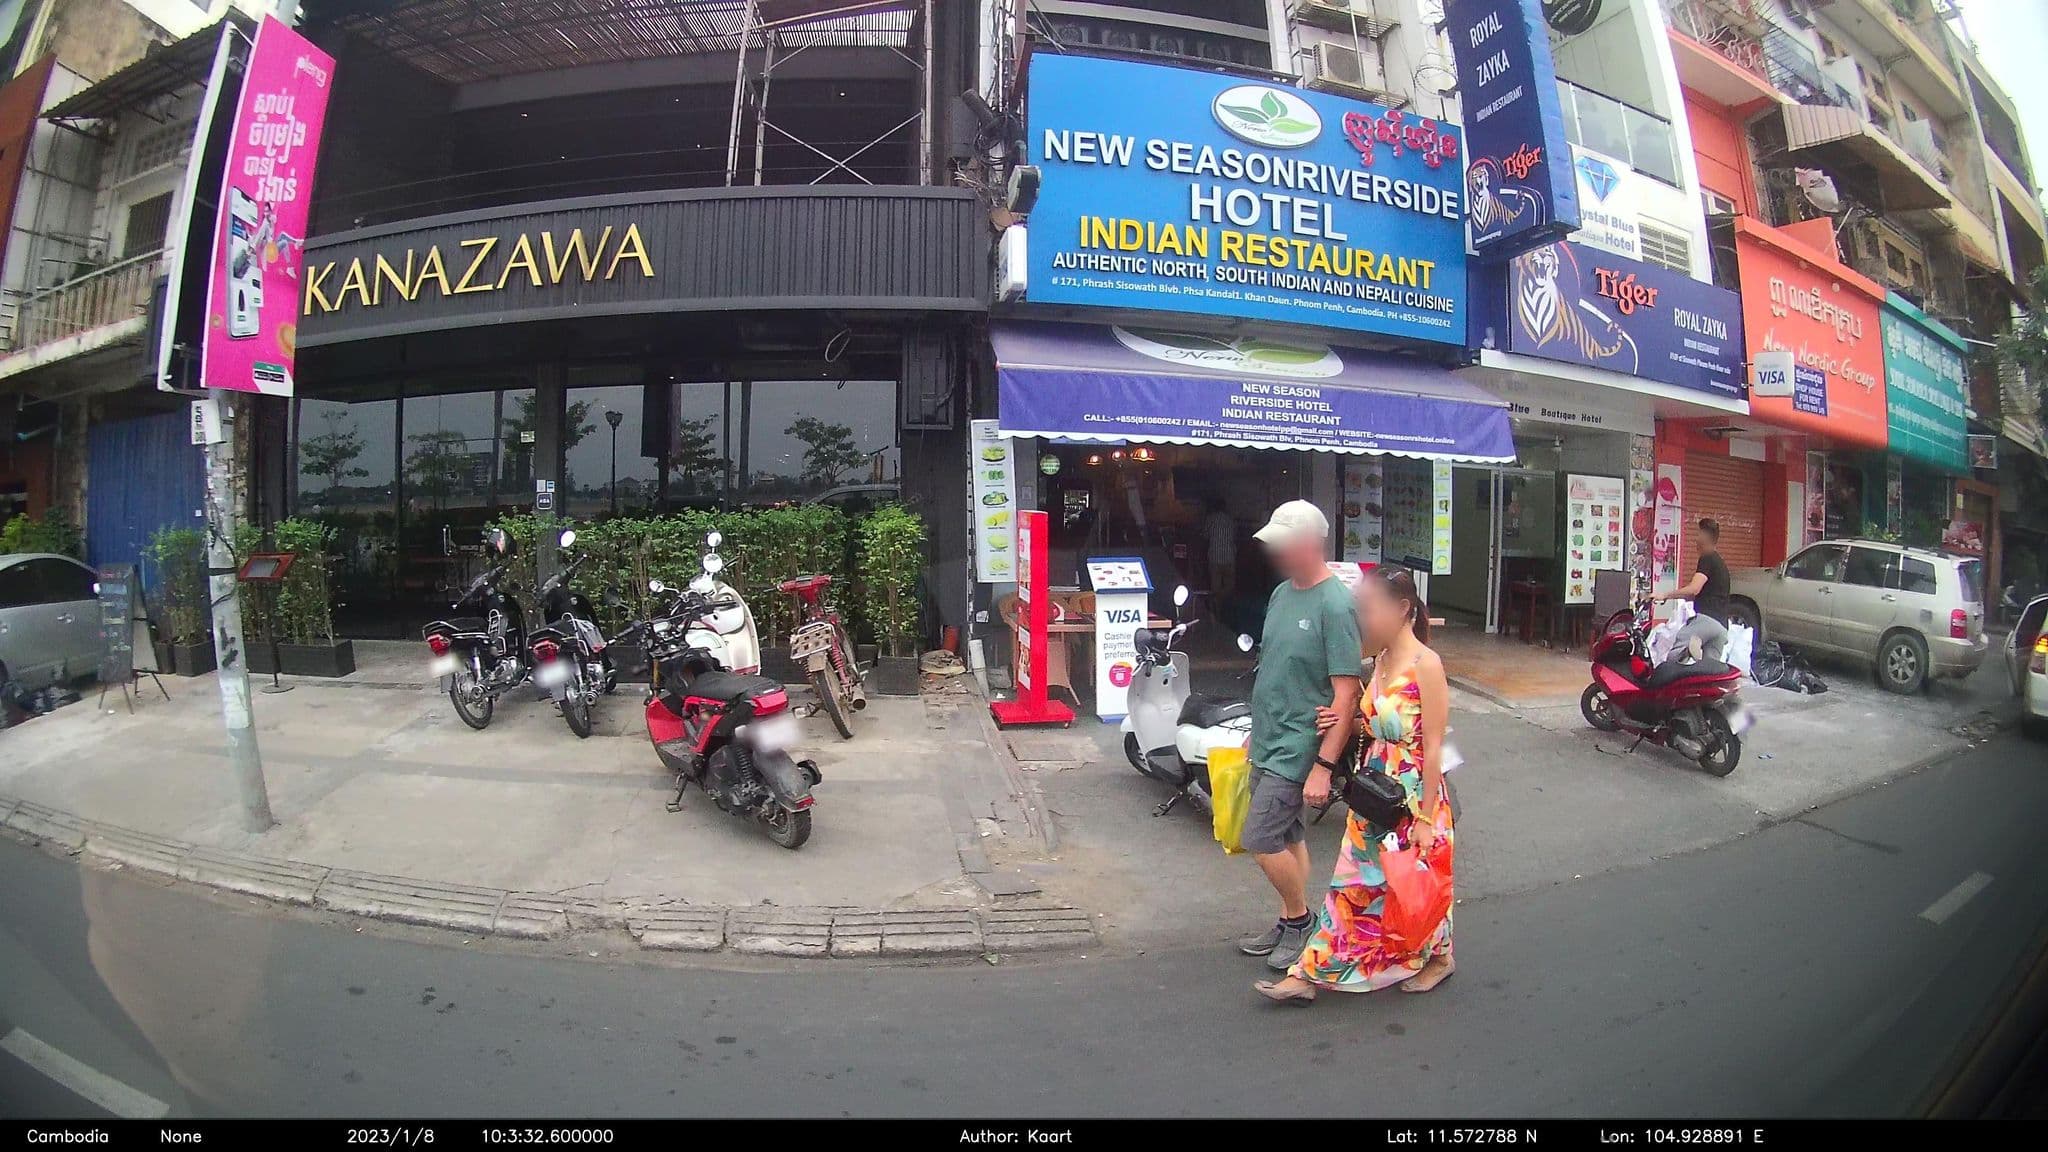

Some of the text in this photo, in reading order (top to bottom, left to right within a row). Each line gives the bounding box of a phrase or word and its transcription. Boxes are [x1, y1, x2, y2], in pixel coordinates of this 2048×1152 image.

[1470, 11, 1502, 48] ROYAL
[1476, 49, 1510, 87] ZAYKA
[1492, 85, 1523, 113] RESTAURANT
[1044, 129, 1135, 166] NEW
[1503, 143, 1542, 180] Tiger
[1191, 183, 1347, 242] HOTEL
[1581, 209, 1634, 233] ystal Blue
[1080, 216, 1435, 289] INDIAN RESTAURANT
[1605, 232, 1635, 252] Hotel
[303, 222, 655, 316] KANAZAWA
[1053, 252, 1454, 313] AUTHENTIC NORTH, SOUTH INDIAN AND NEPALI CUISINE
[1060, 277, 1080, 287] 171,
[1082, 278, 1114, 289] Phrash
[1115, 281, 1157, 292] Sisowath
[1183, 287, 1203, 296] Phsa
[1244, 292, 1266, 303] Khan
[1294, 298, 1322, 309] Phnom
[1323, 302, 1345, 314] Penh,
[1346, 305, 1386, 319] Cambodia.
[1387, 311, 1398, 320] PH
[1594, 267, 1658, 315] Tiger
[1674, 308, 1728, 341] ROYAL ZAYKA
[1758, 371, 1785, 384] VISA
[1798, 339, 1838, 375] Nordic
[1841, 358, 1876, 394] Group
[1230, 395, 1333, 412] RIVERSIDE HOTEL
[1243, 383, 1320, 399] NEW SEASON
[1222, 408, 1341, 426] INDIAN RESTAURANT
[1508, 403, 1602, 423] Blue Boutique Hotel
[1214, 431, 1241, 439] Phrash
[1243, 433, 1278, 442] Sisowath
[1295, 436, 1320, 444] Phnom
[1343, 440, 1378, 448] Cambodia
[1103, 609, 1141, 623] VISA
[1104, 632, 1132, 641] Cashle
[1104, 650, 1136, 659] preferre
